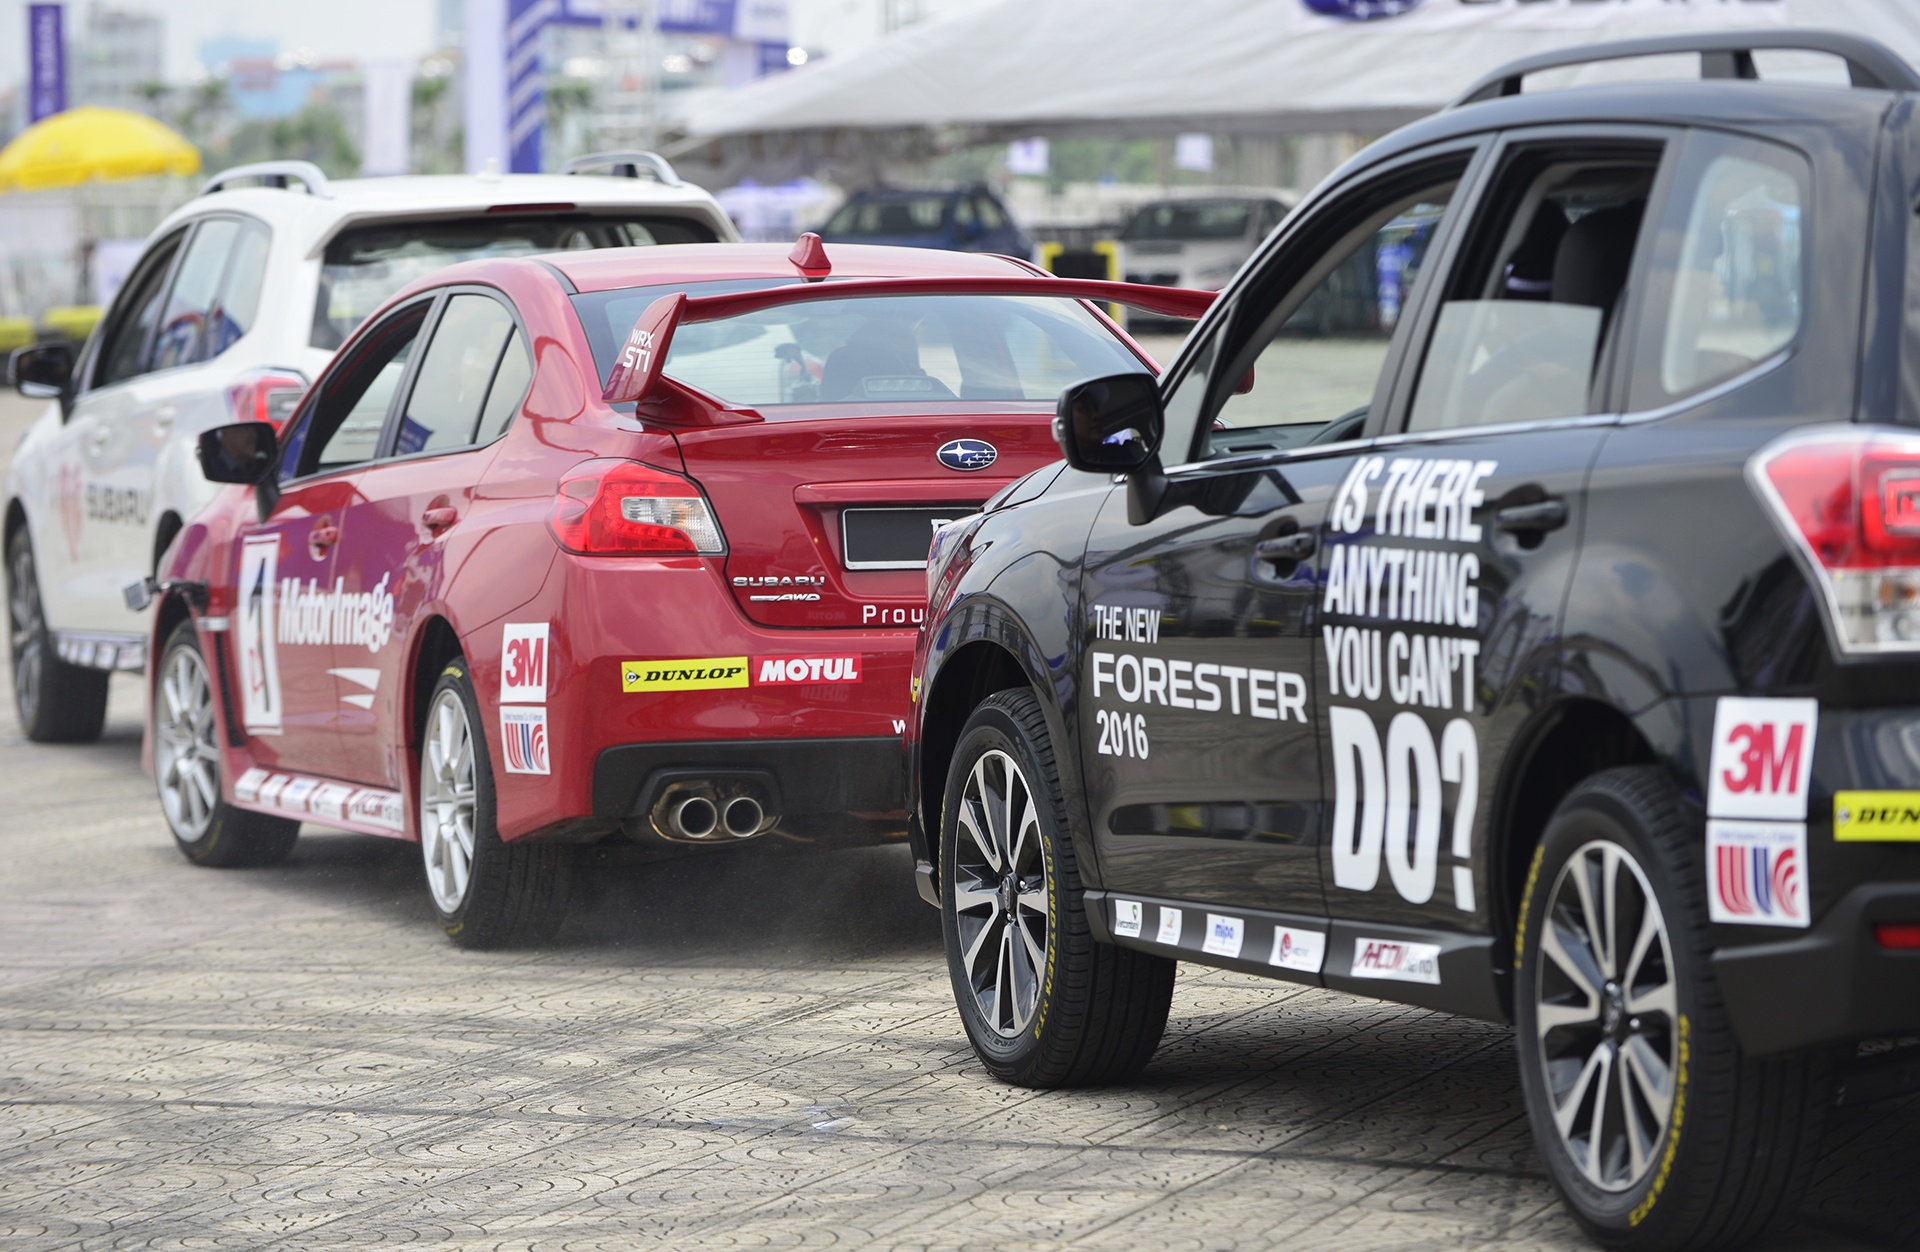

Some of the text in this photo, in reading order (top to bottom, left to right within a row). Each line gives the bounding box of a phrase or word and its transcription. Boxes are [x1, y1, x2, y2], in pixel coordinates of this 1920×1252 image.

[622, 345, 651, 373] STI
[630, 328, 655, 348] WRX
[1330, 456, 1498, 542] IS THERE
[733, 576, 825, 587] SUBARU
[777, 594, 820, 602] AWD
[1323, 544, 1480, 627] ANYTHING
[278, 571, 394, 653] MotorImage
[1094, 604, 1161, 644] THE NEW
[505, 638, 544, 687] 3M
[644, 667, 742, 682] DUNLOP
[759, 658, 857, 683] MOTUL
[1092, 652, 1308, 723] FORESTER
[1323, 625, 1480, 712] YOU CAN'T
[1096, 709, 1149, 760] 2016
[1723, 723, 1804, 795] 3M
[1329, 705, 1480, 913] DO?
